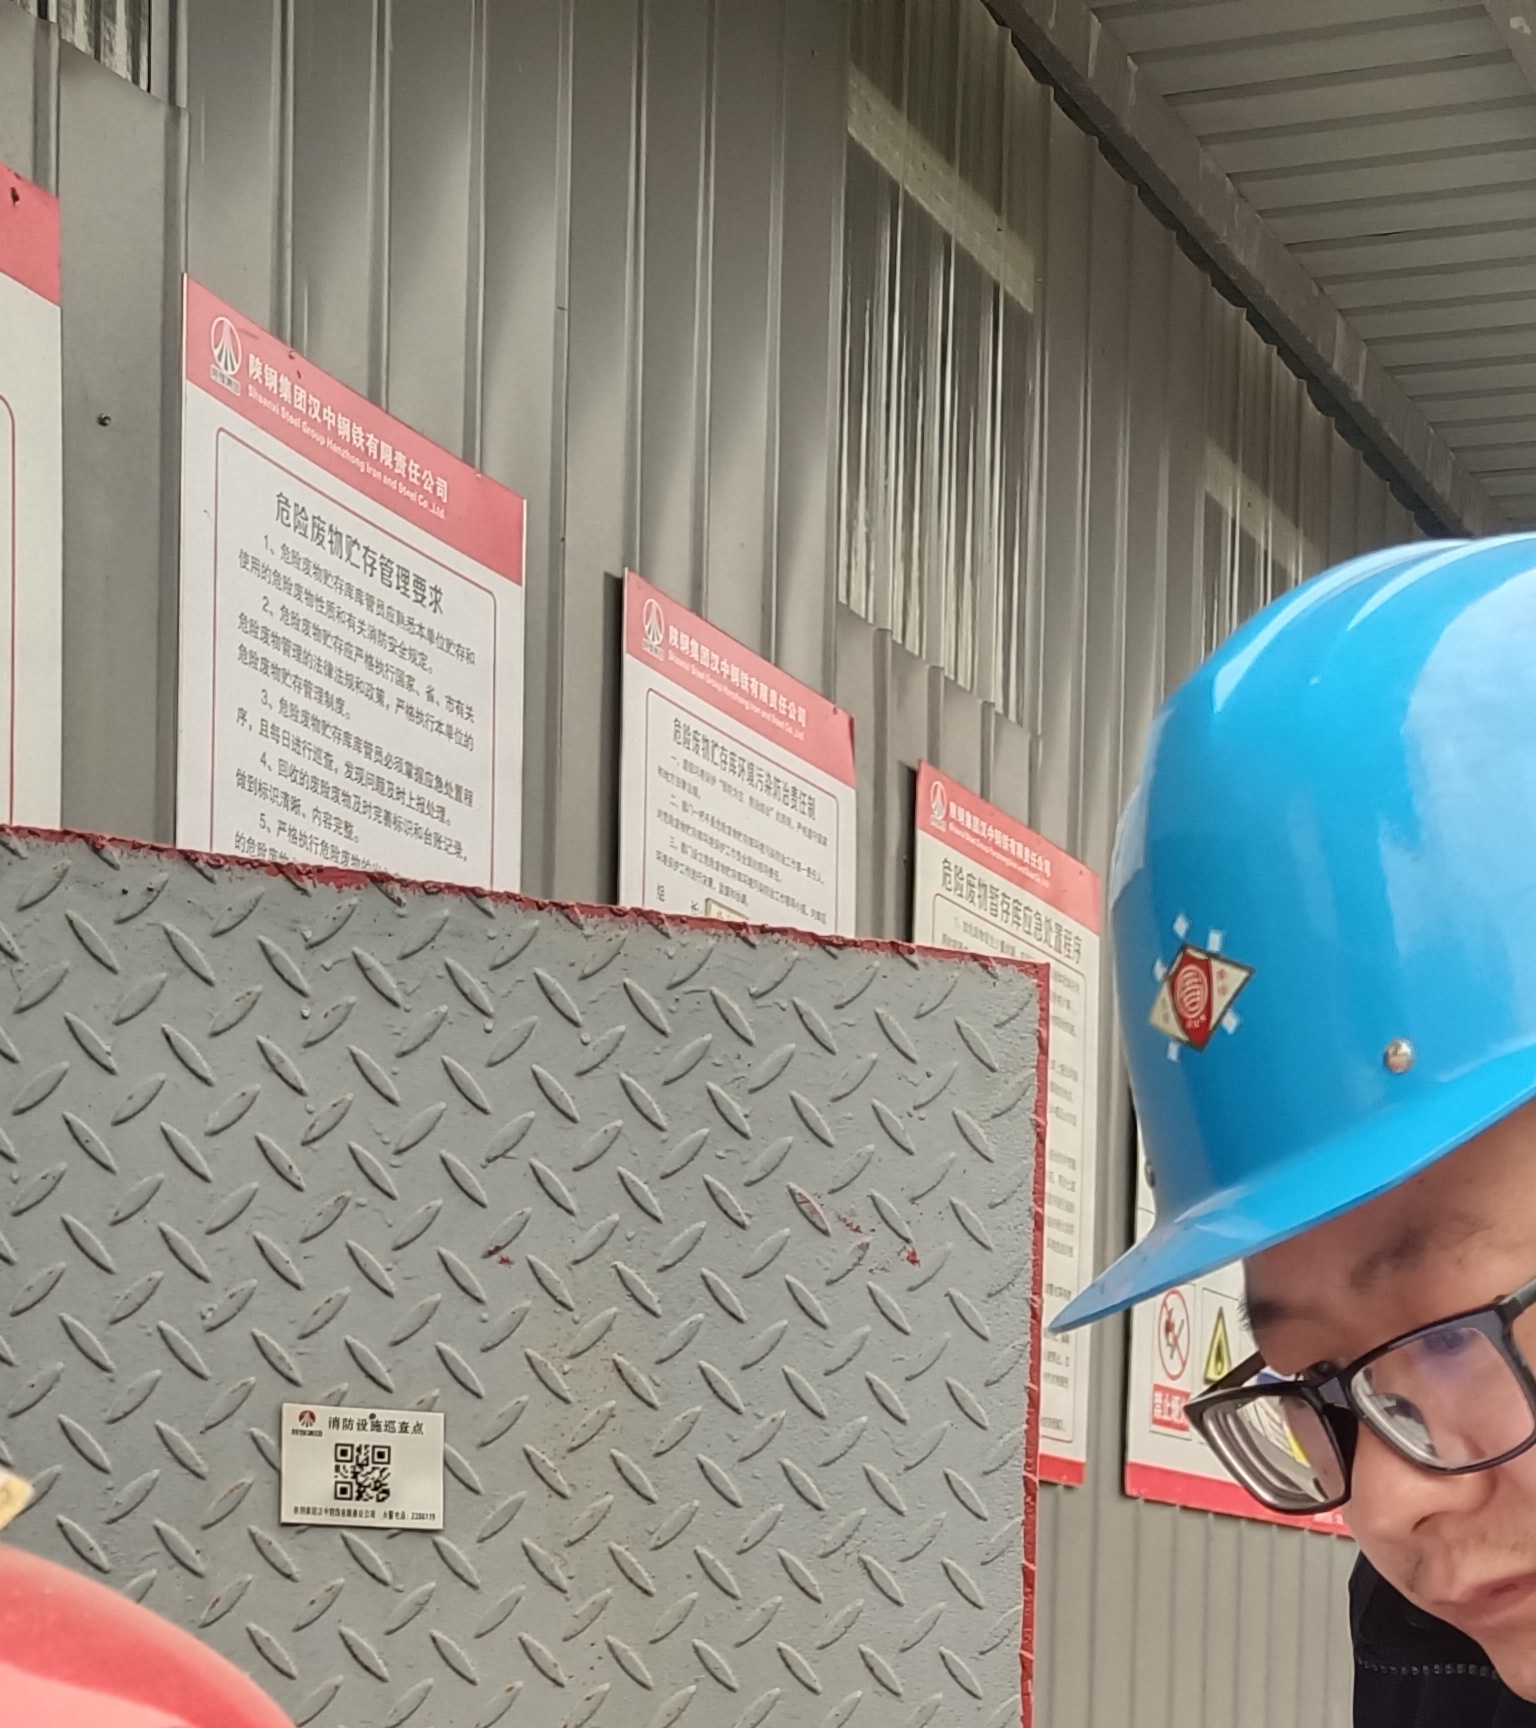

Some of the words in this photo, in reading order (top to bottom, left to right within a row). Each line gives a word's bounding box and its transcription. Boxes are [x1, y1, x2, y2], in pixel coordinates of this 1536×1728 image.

[276, 492, 443, 615] 危险废物贮存管理要求
[328, 1416, 425, 1436] 消防设施巡查点
